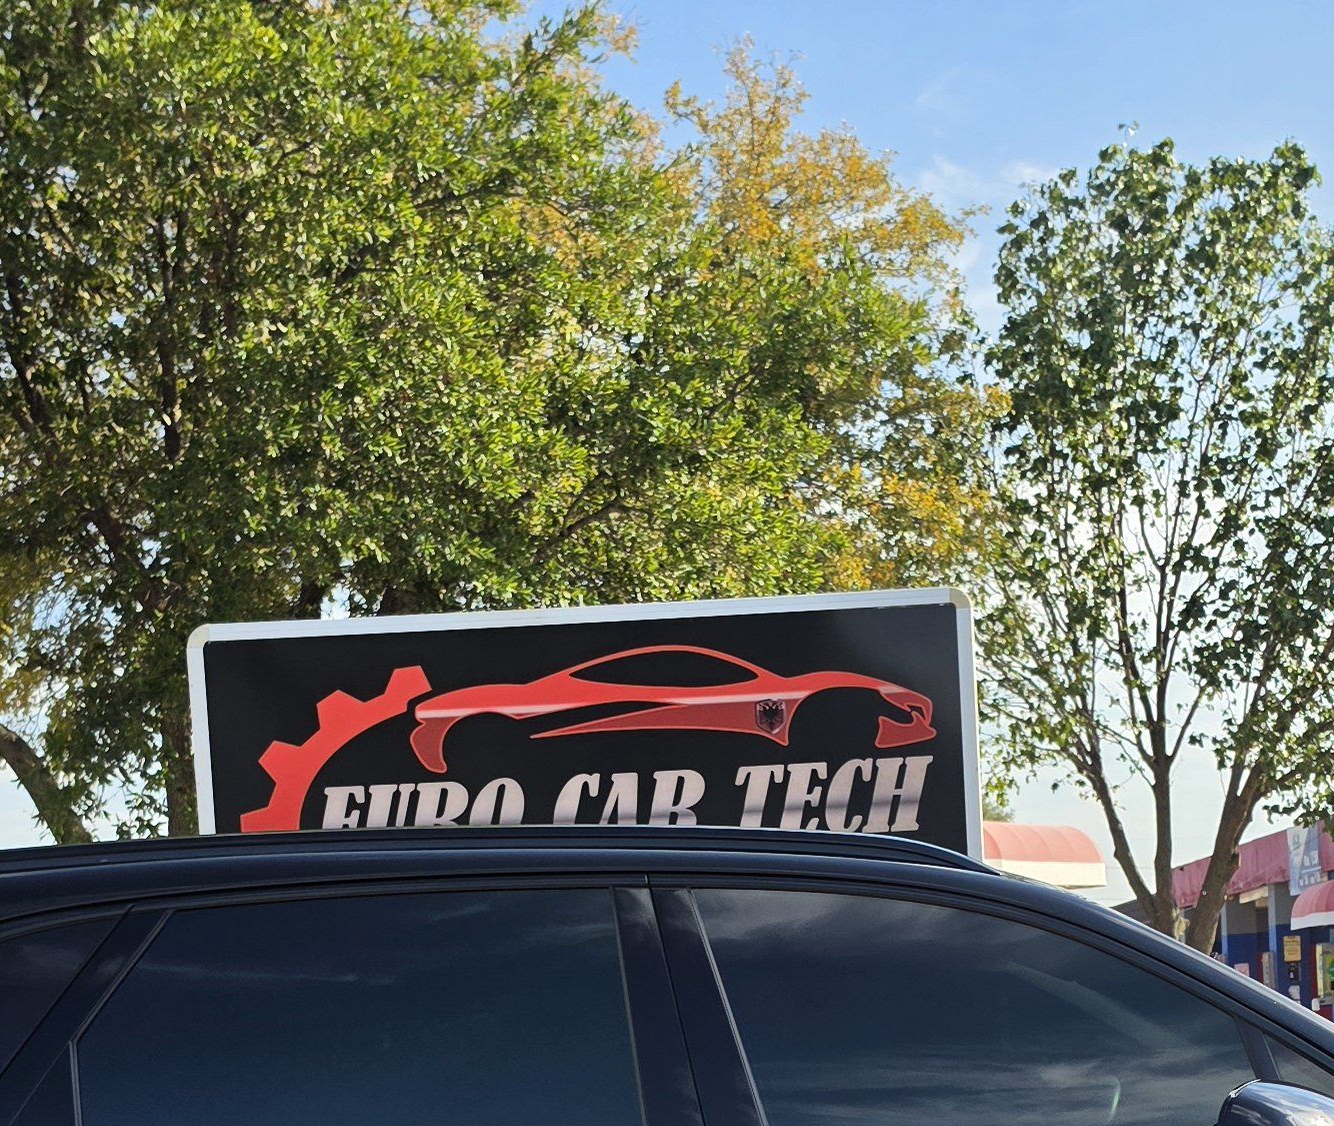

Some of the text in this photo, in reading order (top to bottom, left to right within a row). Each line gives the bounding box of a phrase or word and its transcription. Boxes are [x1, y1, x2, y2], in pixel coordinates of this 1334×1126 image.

[323, 756, 934, 832] EURO CAR TECH
